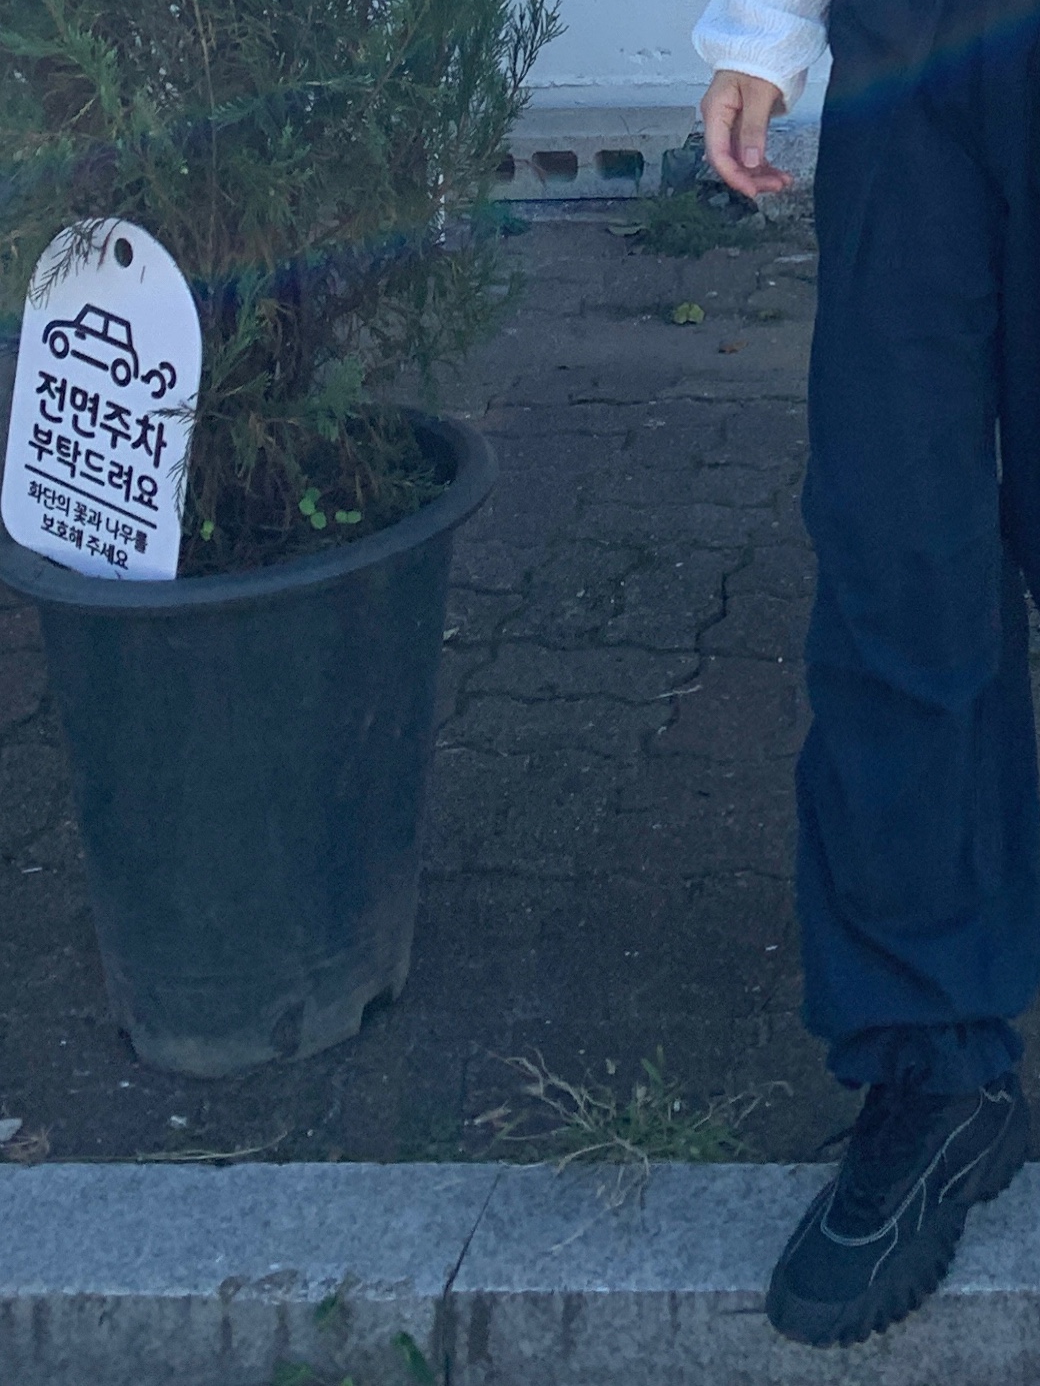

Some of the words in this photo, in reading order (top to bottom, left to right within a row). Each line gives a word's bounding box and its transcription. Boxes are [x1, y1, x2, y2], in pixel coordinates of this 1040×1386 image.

[36, 370, 167, 469] 전면주차
[28, 423, 159, 512] 부탁드려요
[28, 480, 71, 517] 화단의
[73, 501, 103, 532] 꽃과
[105, 516, 149, 554] 나무를
[40, 514, 84, 550] 보호해
[85, 535, 129, 570] 주세요
